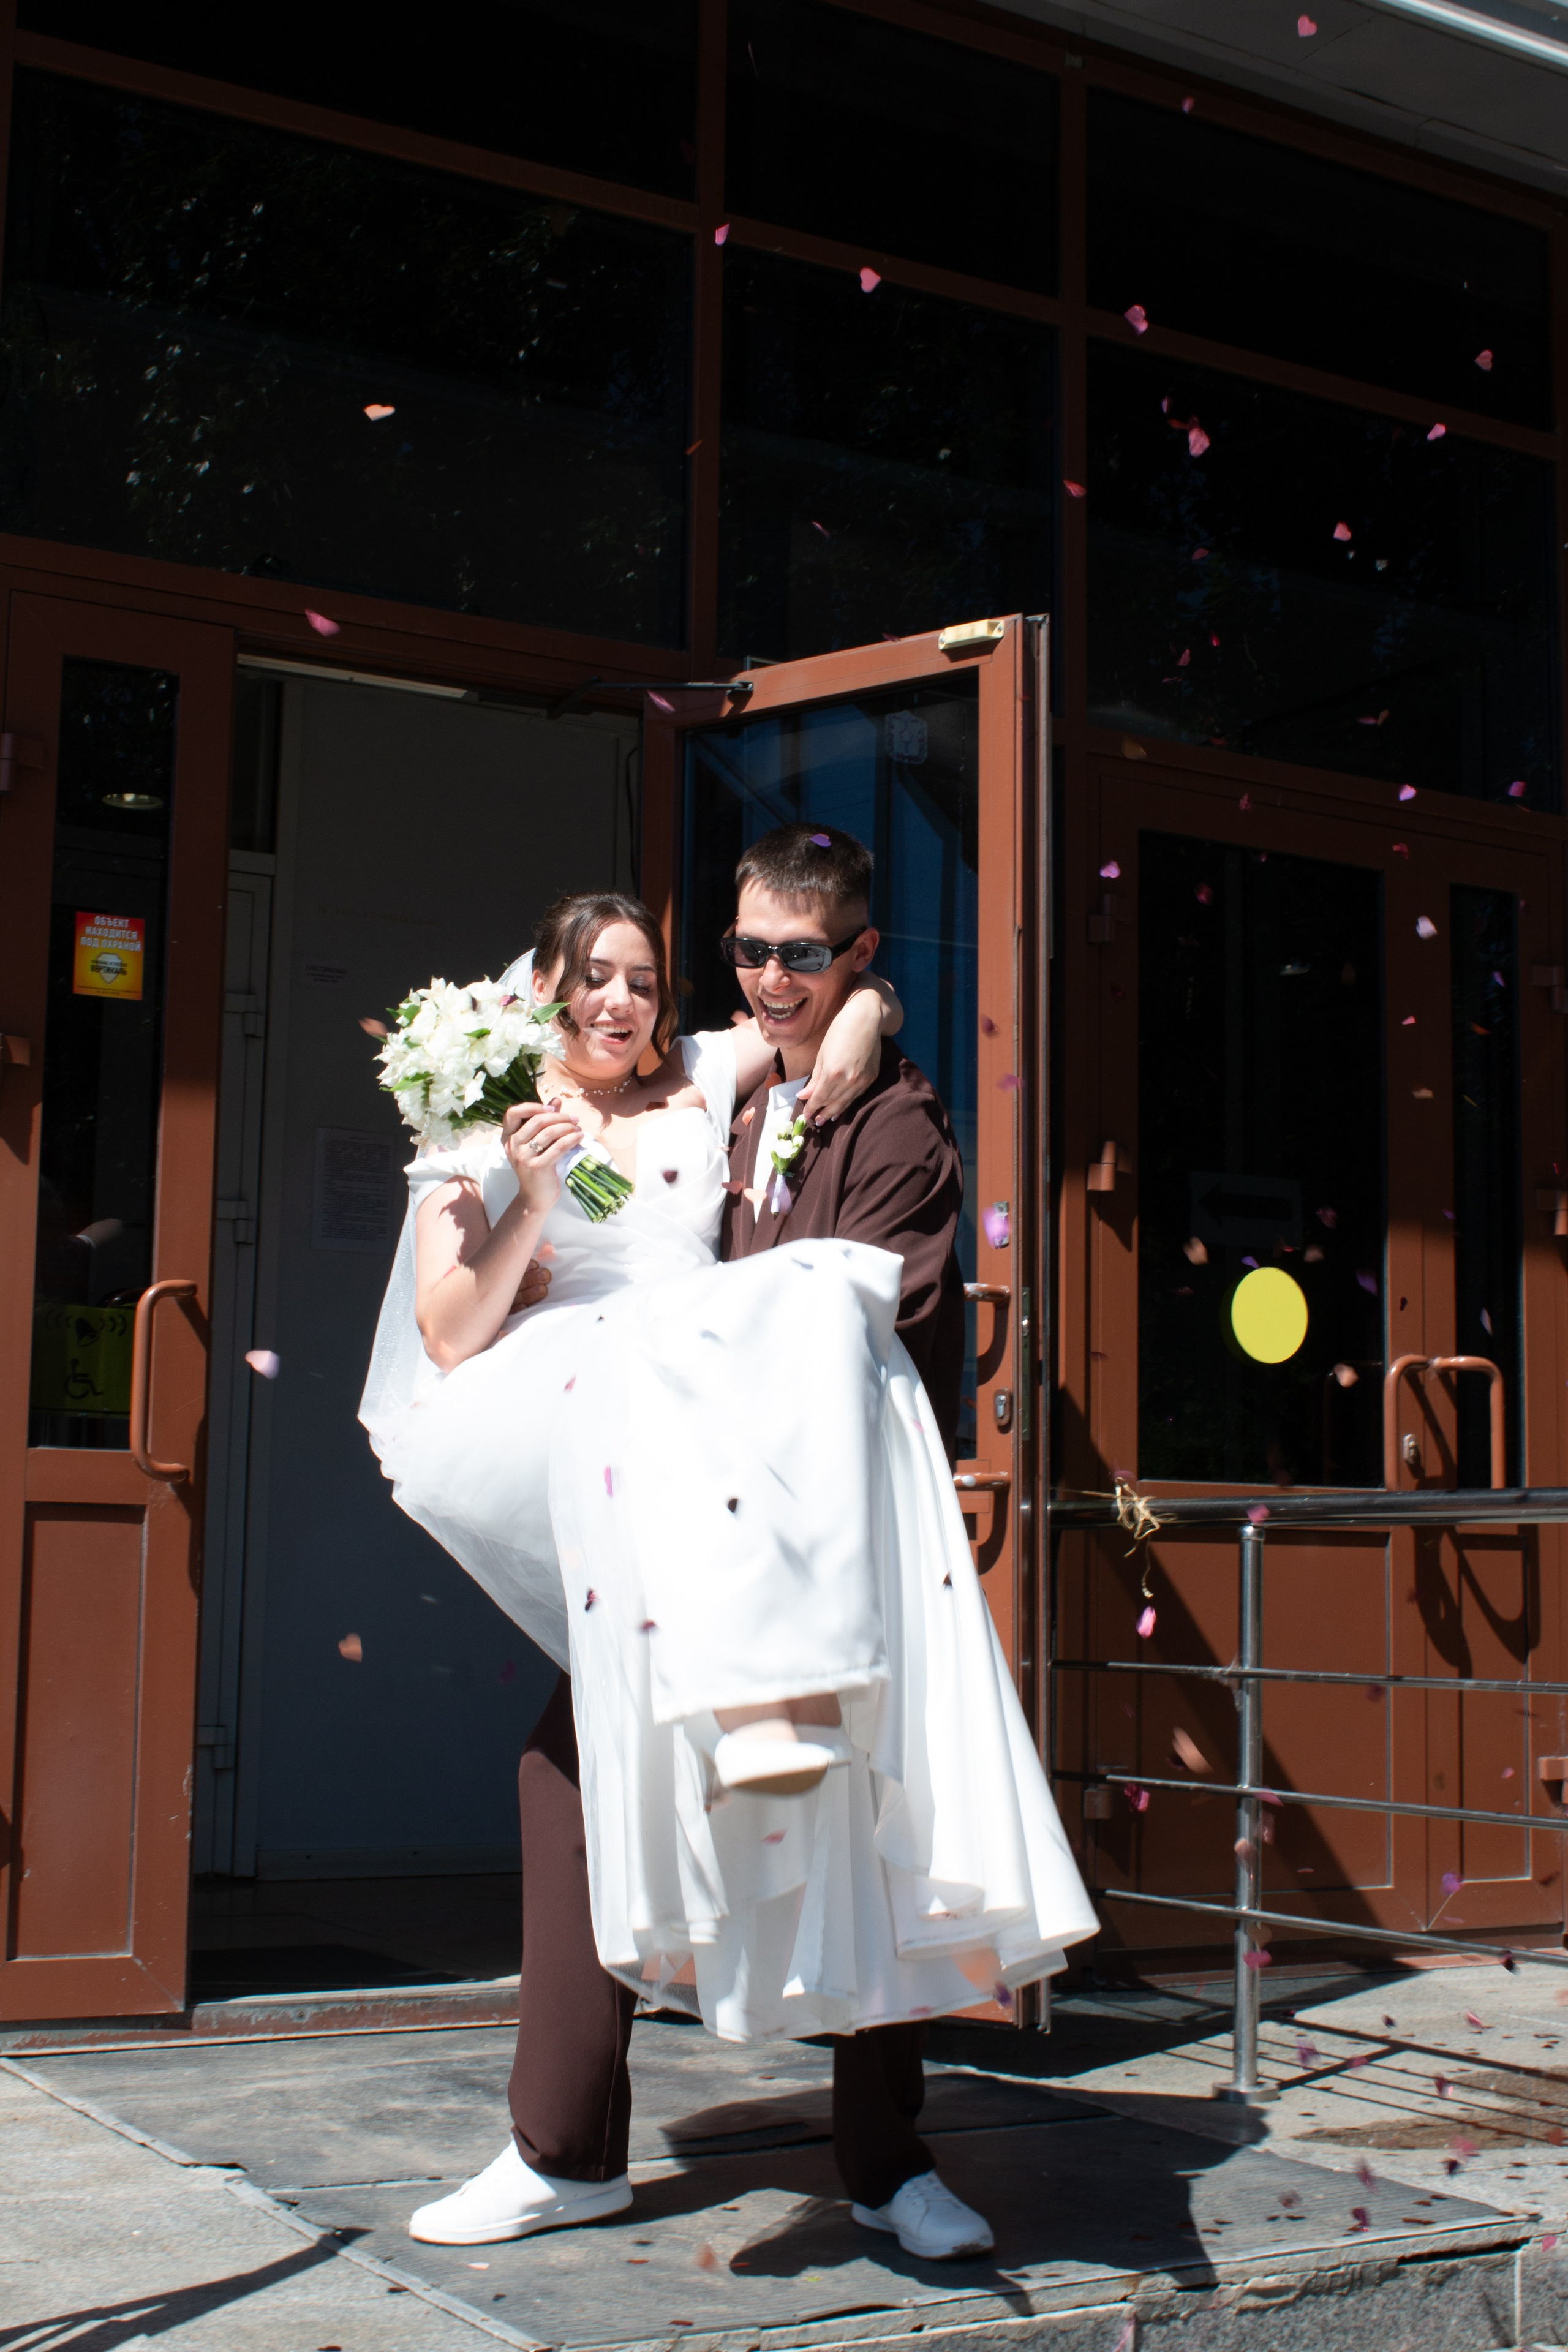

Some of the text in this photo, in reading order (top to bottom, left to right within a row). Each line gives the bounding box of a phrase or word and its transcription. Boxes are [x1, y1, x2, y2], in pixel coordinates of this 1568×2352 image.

[94, 916, 130, 928] ОБЪЕКТ
[85, 926, 138, 940] НАХОДИТСЯ
[80, 937, 141, 952] ПОД ОХРАНОЙ
